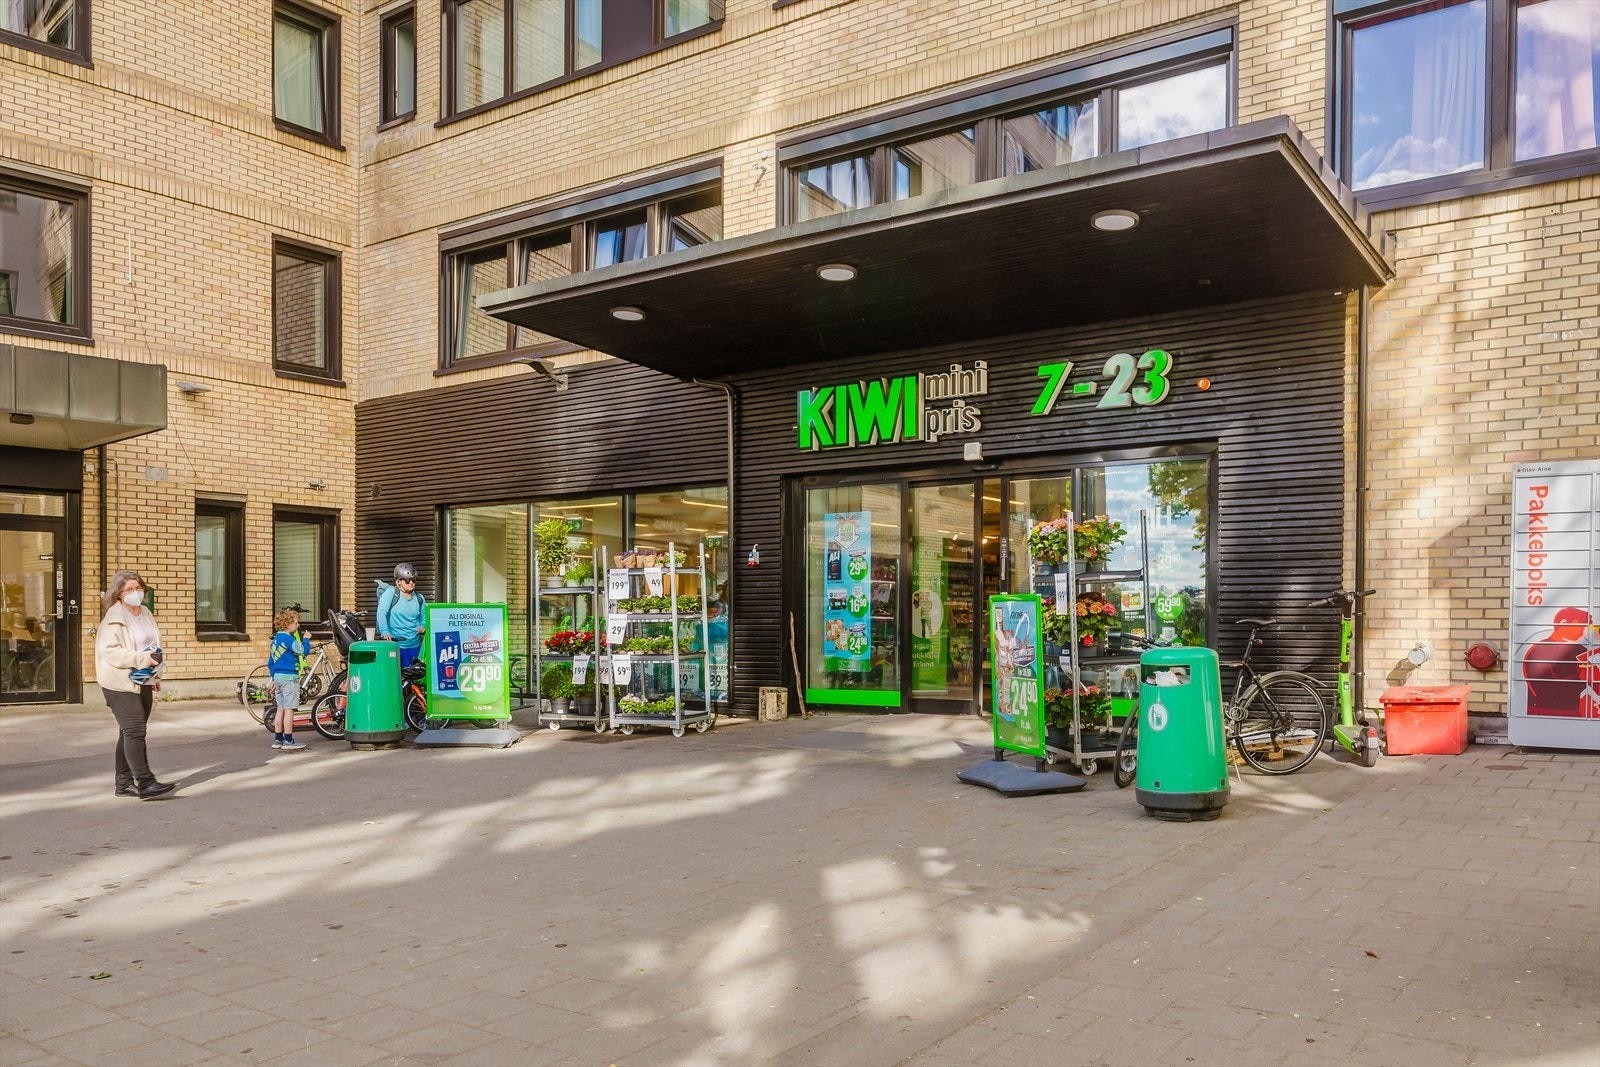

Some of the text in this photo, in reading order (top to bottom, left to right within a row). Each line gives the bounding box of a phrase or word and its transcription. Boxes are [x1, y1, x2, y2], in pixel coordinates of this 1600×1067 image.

[926, 360, 988, 401] mini
[799, 375, 924, 450] KIWI
[925, 400, 981, 442] pris
[1527, 485, 1548, 606] Pakkeboks
